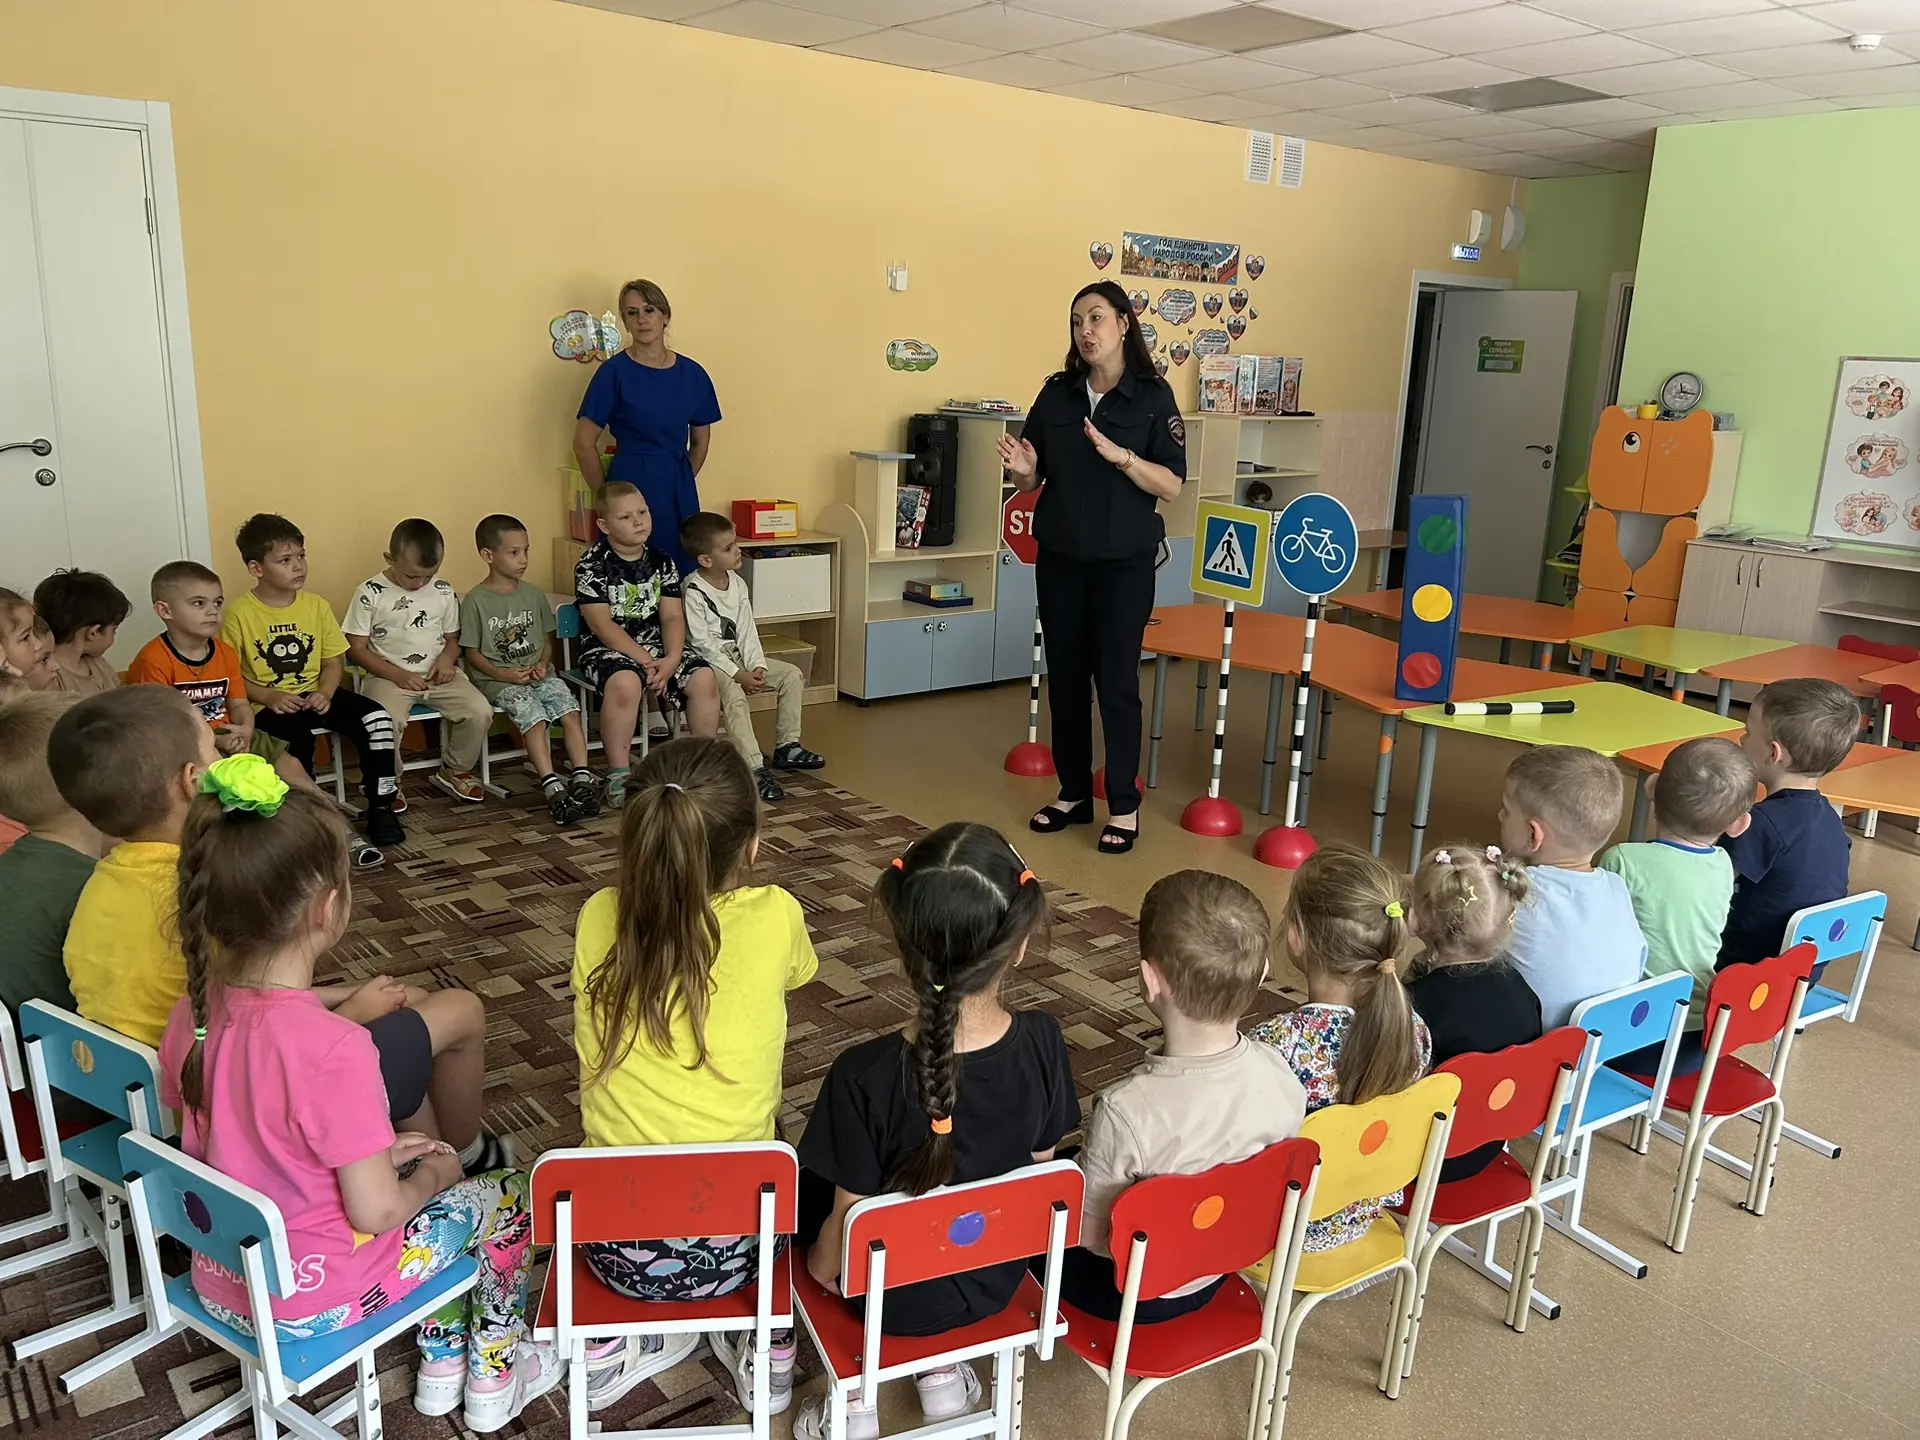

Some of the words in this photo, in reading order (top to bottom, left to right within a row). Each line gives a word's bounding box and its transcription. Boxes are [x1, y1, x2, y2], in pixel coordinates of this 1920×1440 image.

[1158, 238, 1172, 248] ГОД
[1174, 241, 1209, 251] ЕДИНСТВА
[1152, 248, 1185, 260] НАРОДОВ
[1186, 251, 1214, 262] РОССИИ
[1009, 509, 1035, 536] ST
[269, 623, 297, 634] LITTLE
